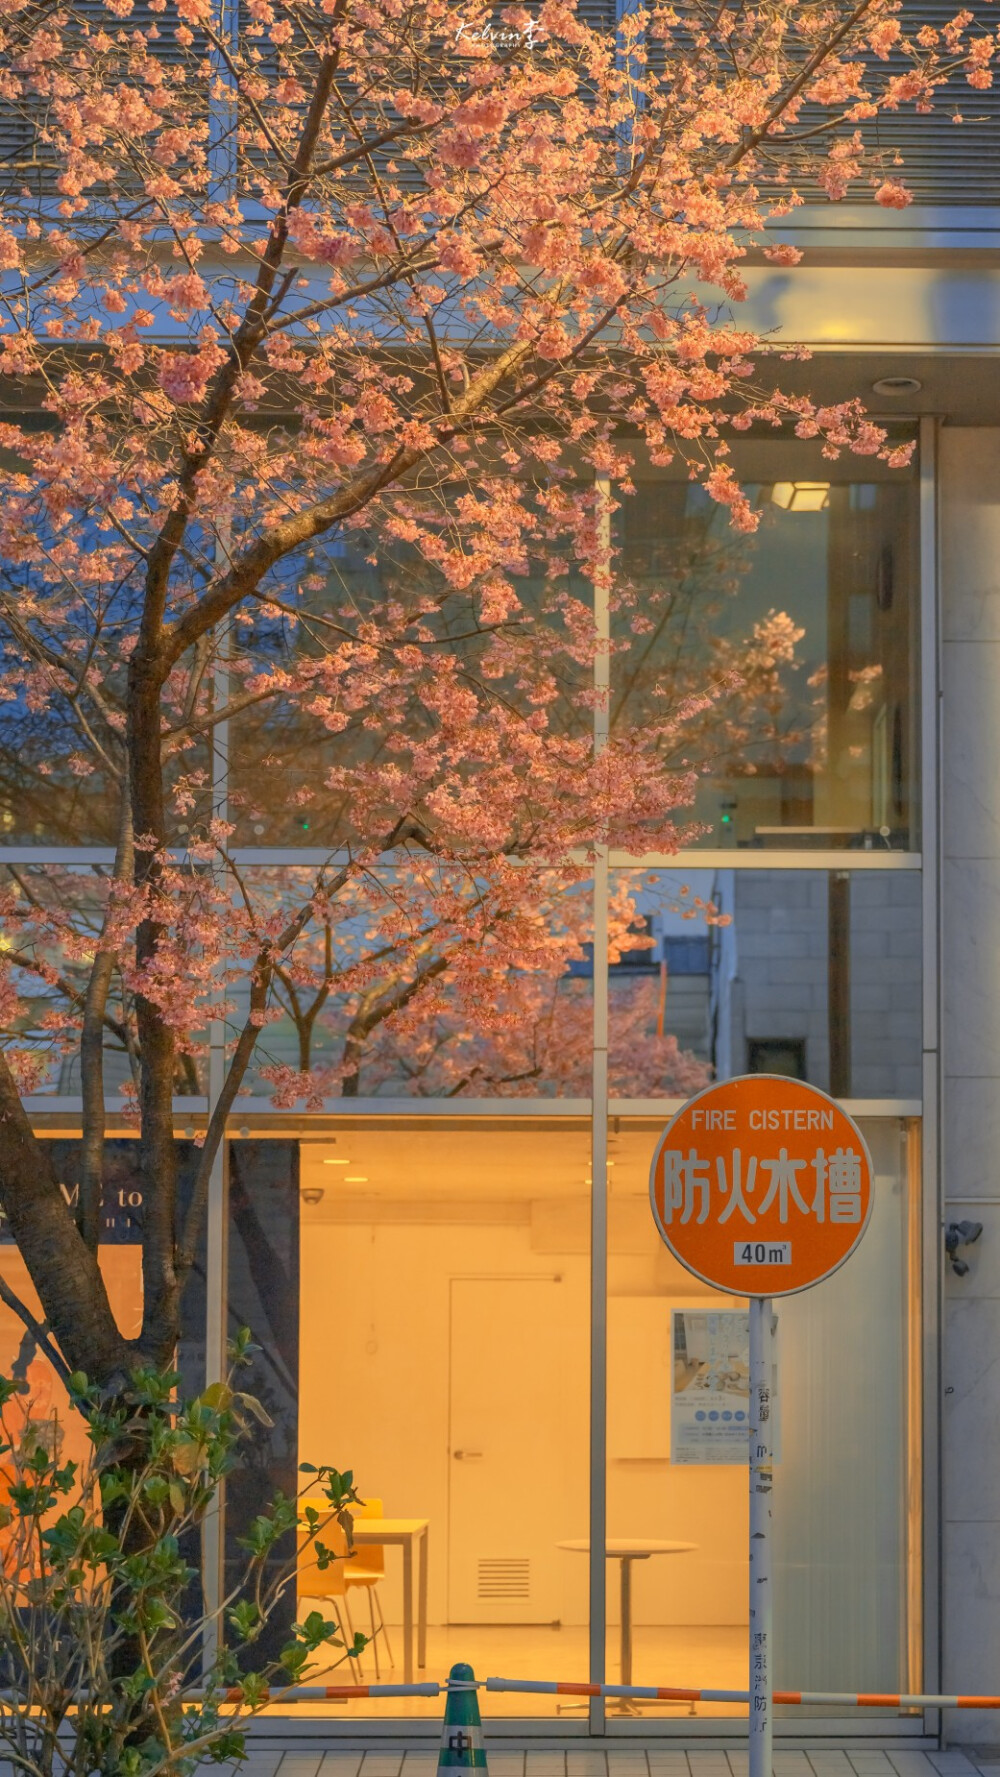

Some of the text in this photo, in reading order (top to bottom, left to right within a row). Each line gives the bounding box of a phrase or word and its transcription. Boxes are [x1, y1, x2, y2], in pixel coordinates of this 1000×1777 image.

[691, 1109, 834, 1130] FIRE CISTERN
[664, 1147, 862, 1225] 防火水槽
[117, 1188, 143, 1208] to
